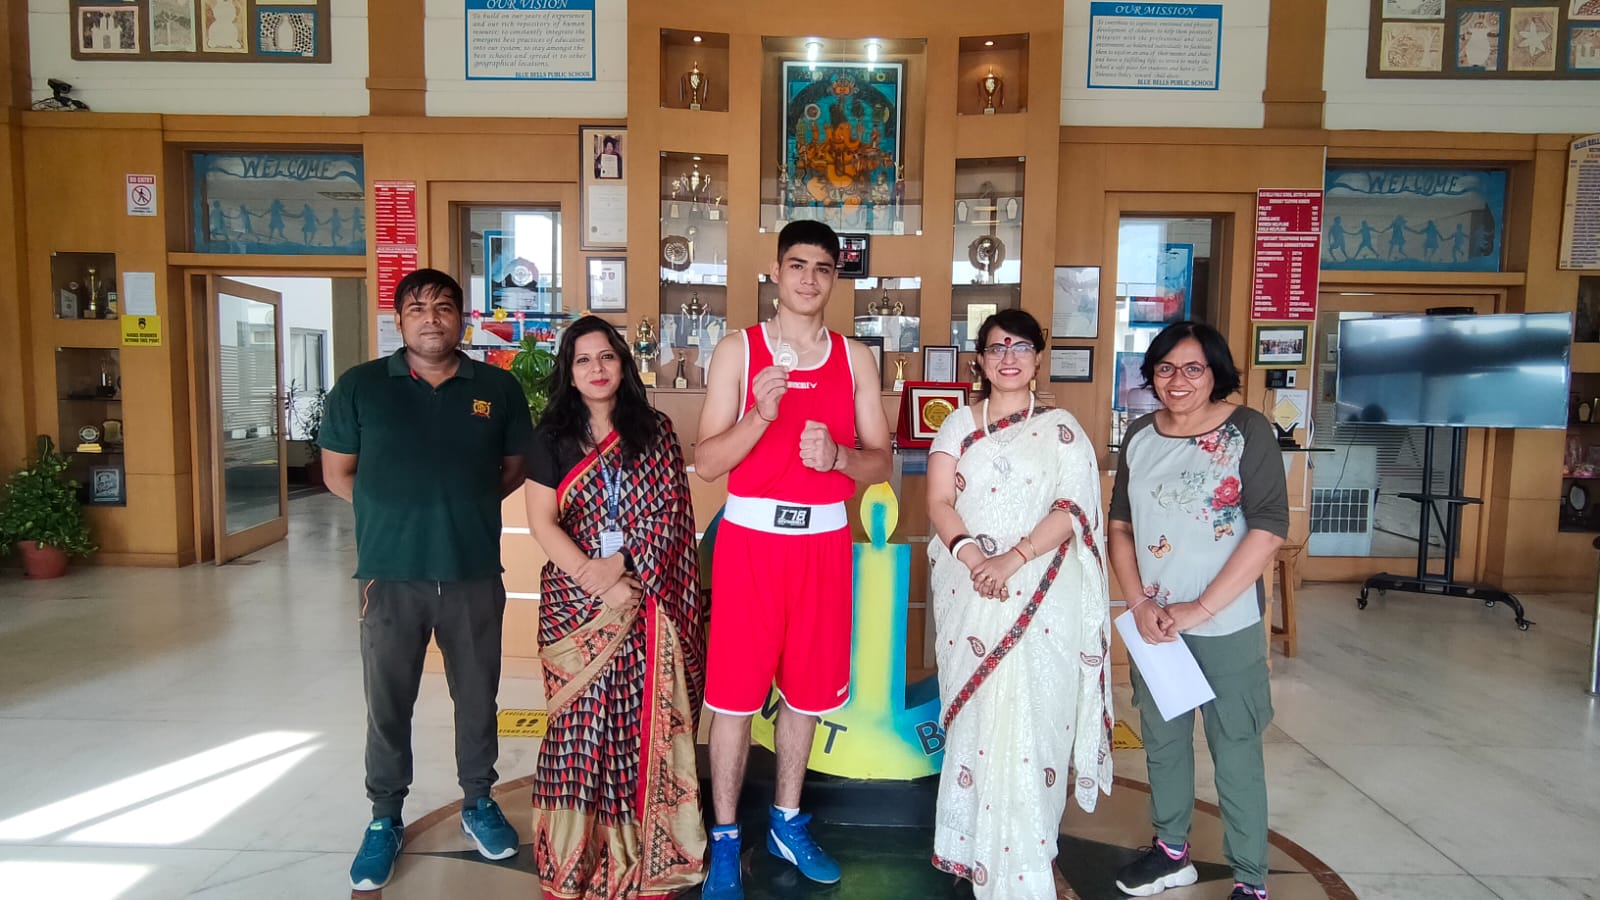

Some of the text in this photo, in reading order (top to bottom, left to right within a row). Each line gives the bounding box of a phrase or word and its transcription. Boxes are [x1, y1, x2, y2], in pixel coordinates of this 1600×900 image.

[486, 0, 568, 9] OUR VISION
[1115, 5, 1197, 16] OUR MISSION
[241, 156, 333, 178] WELCOME
[1367, 172, 1462, 194] WELCOME
